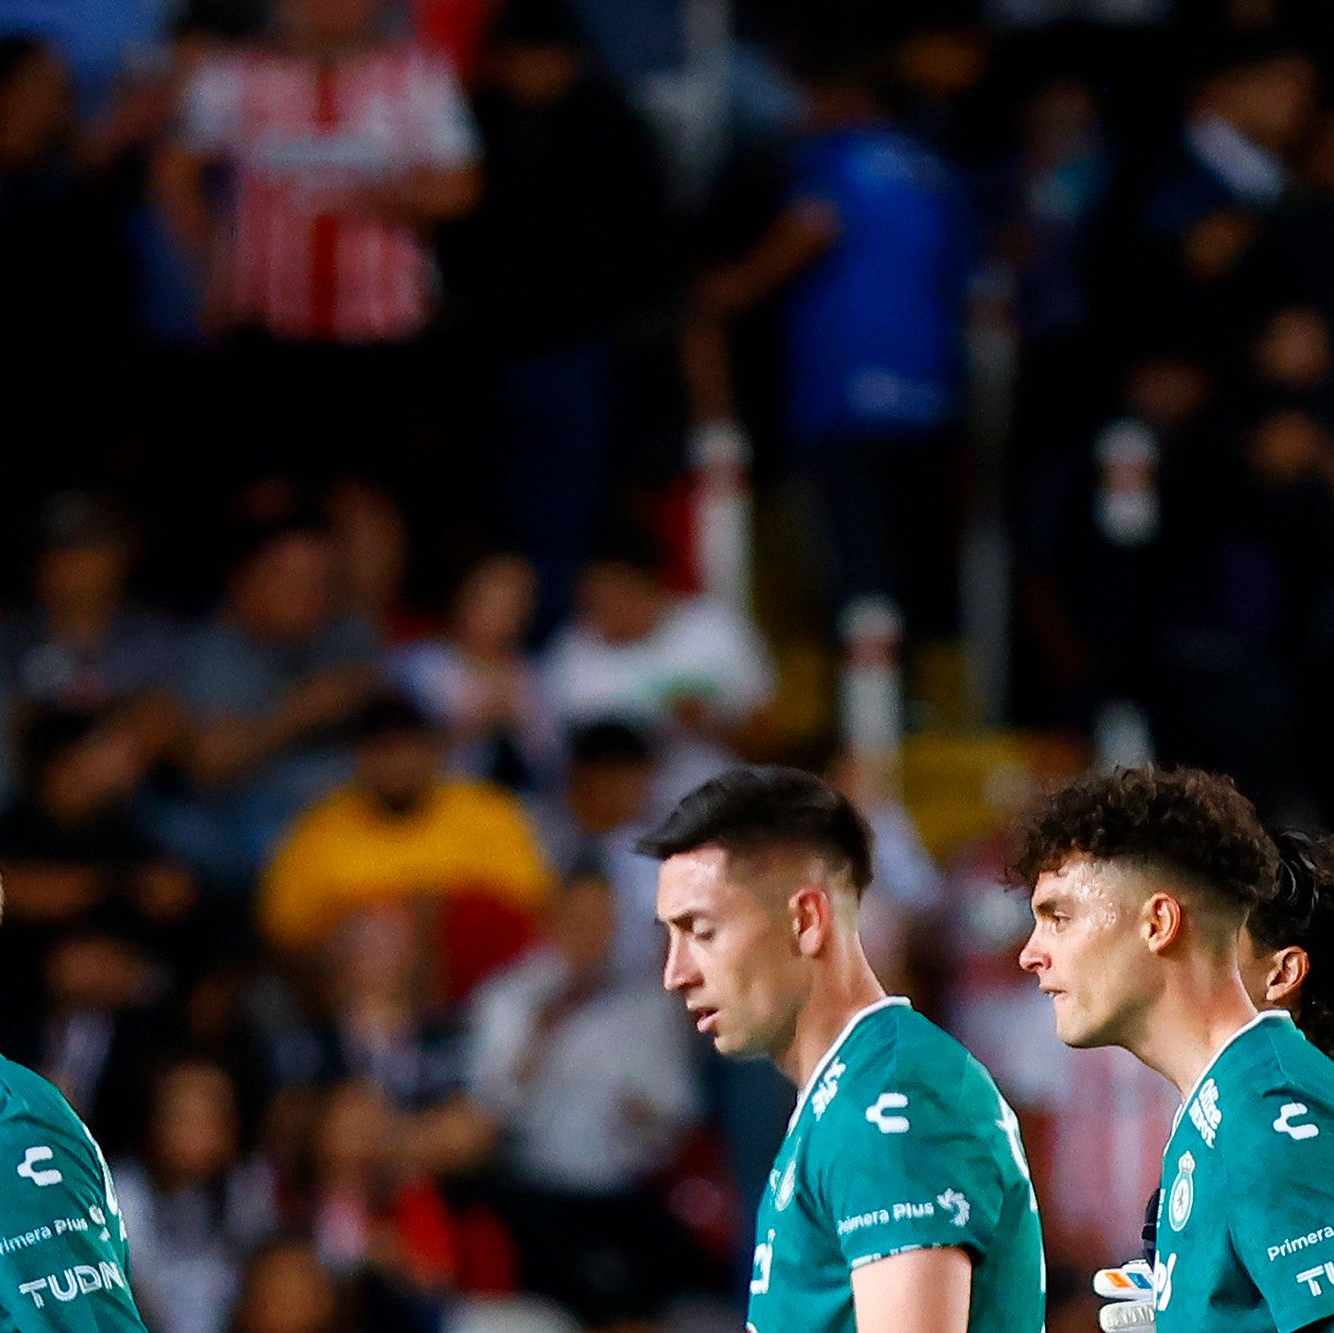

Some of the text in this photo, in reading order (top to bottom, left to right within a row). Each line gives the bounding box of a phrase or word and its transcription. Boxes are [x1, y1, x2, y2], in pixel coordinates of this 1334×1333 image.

[893, 1202, 934, 1221] Plus
[1267, 1226, 1334, 1261] Primera
[19, 1261, 124, 1309] TUDN
